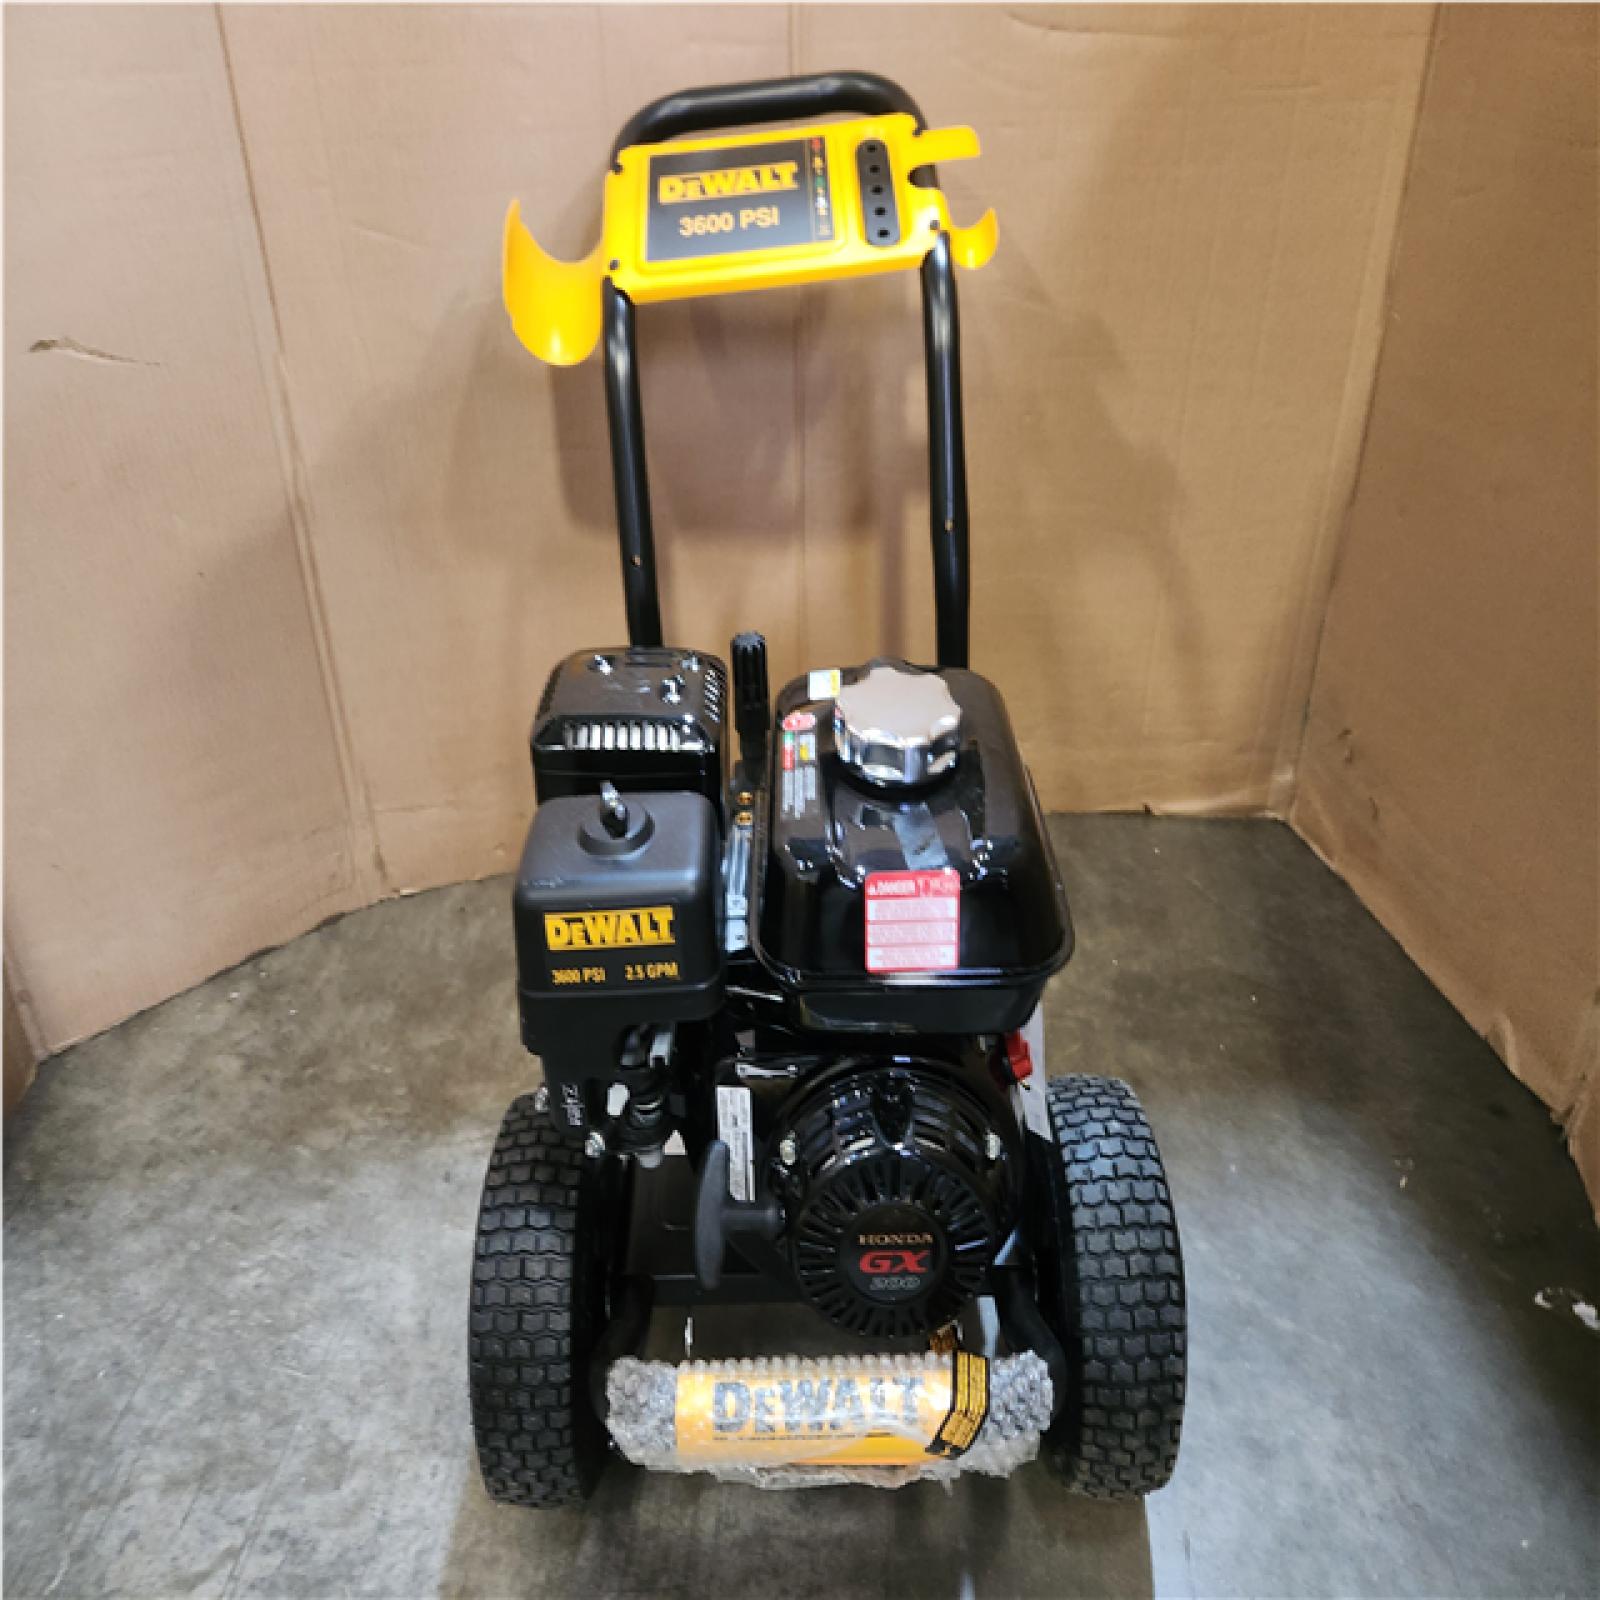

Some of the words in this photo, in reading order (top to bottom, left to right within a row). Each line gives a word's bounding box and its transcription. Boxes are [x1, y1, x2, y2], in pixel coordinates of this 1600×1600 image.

[679, 211, 734, 238] 3600
[739, 206, 780, 230] PSI
[582, 966, 606, 984] PSI
[646, 961, 680, 981] GPM
[858, 1232, 934, 1246] HONDA
[859, 1250, 930, 1275] GX
